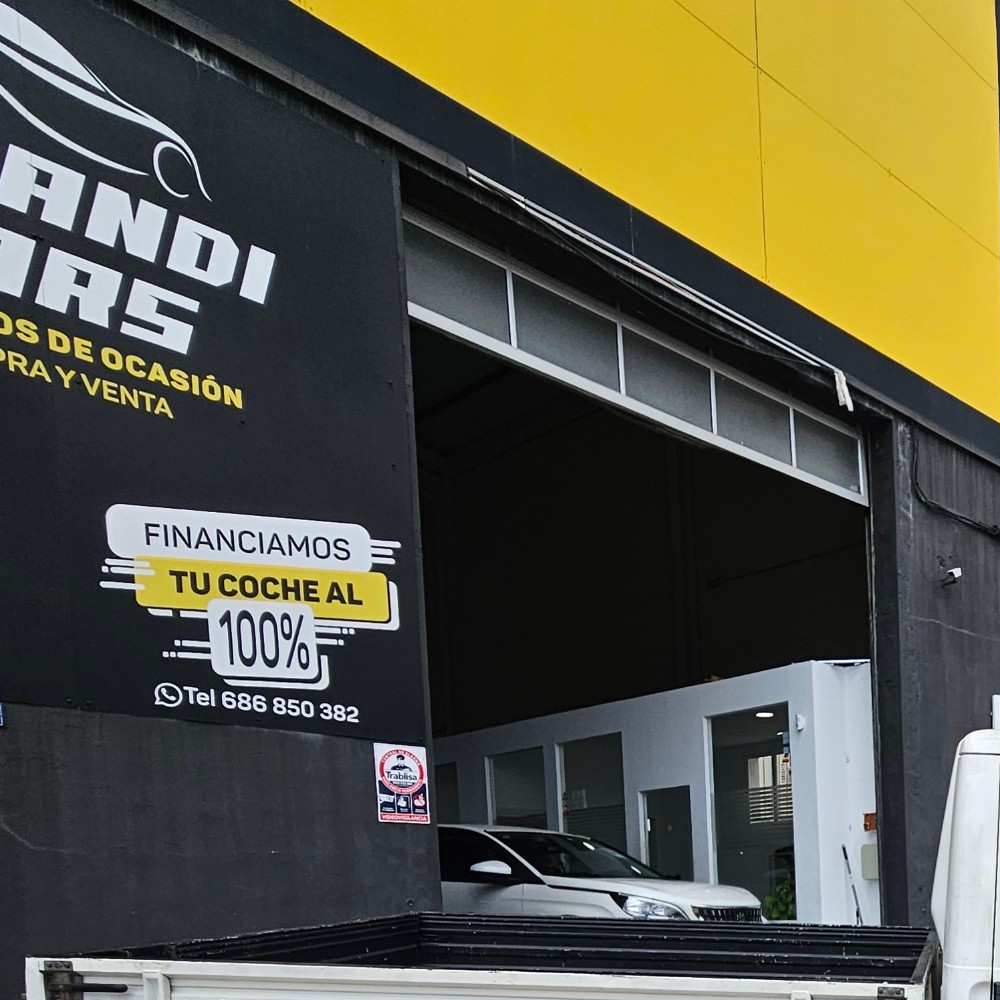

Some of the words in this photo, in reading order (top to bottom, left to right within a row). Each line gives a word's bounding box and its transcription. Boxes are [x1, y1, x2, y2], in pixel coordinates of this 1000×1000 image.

[0, 143, 276, 305] ANDI
[47, 328, 94, 363] DE
[100, 346, 243, 410] OCASIÓN
[54, 365, 76, 389] Y
[80, 372, 174, 420] VENTA
[144, 522, 352, 561] FINANCIAMOS
[168, 570, 211, 595] TU
[218, 573, 320, 603] COCHE
[326, 581, 364, 606] AL
[218, 609, 310, 671] 100%
[182, 686, 216, 707] Tel
[221, 690, 268, 713] 686
[272, 697, 315, 718] 850
[319, 702, 360, 723] 382
[385, 771, 418, 781] Trablisa
